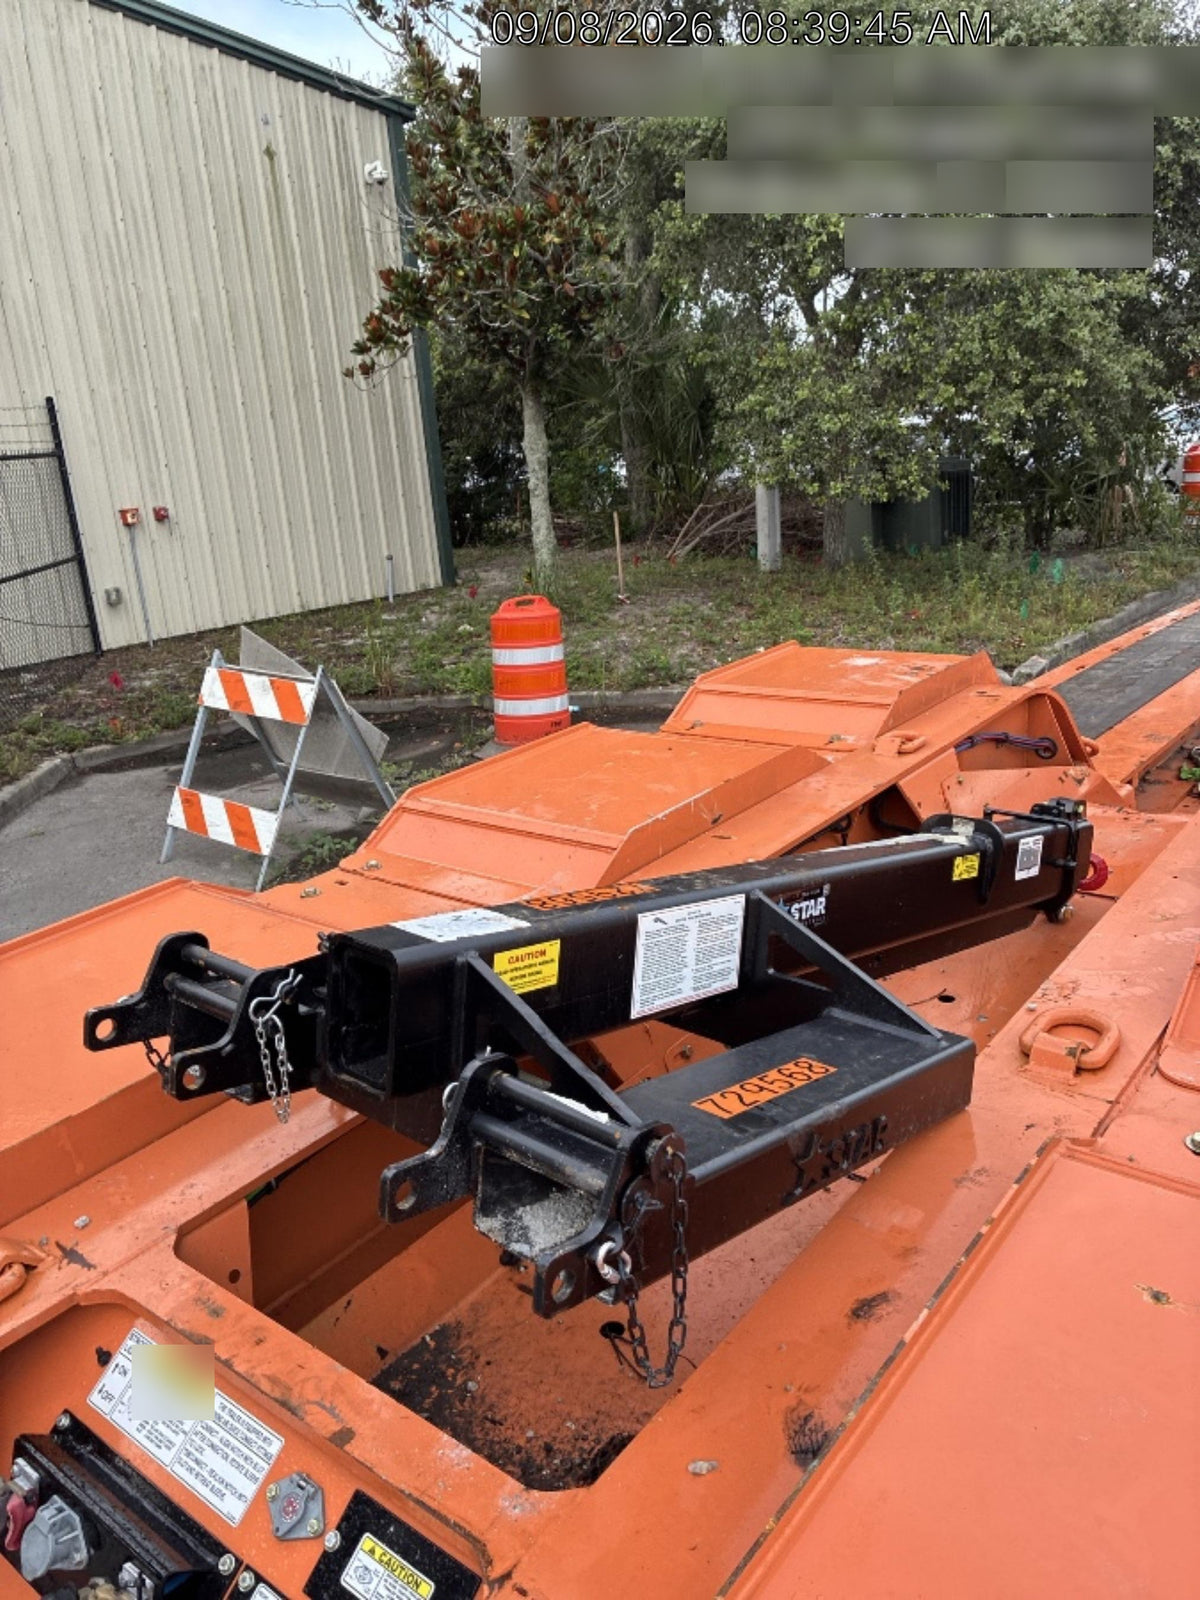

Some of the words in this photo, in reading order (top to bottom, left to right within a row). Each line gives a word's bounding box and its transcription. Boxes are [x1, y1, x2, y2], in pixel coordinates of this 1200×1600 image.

[790, 896, 826, 920] STAR
[507, 948, 547, 965] CAUTION
[696, 1059, 831, 1115] 729568
[377, 1551, 422, 1592] CAUTION
